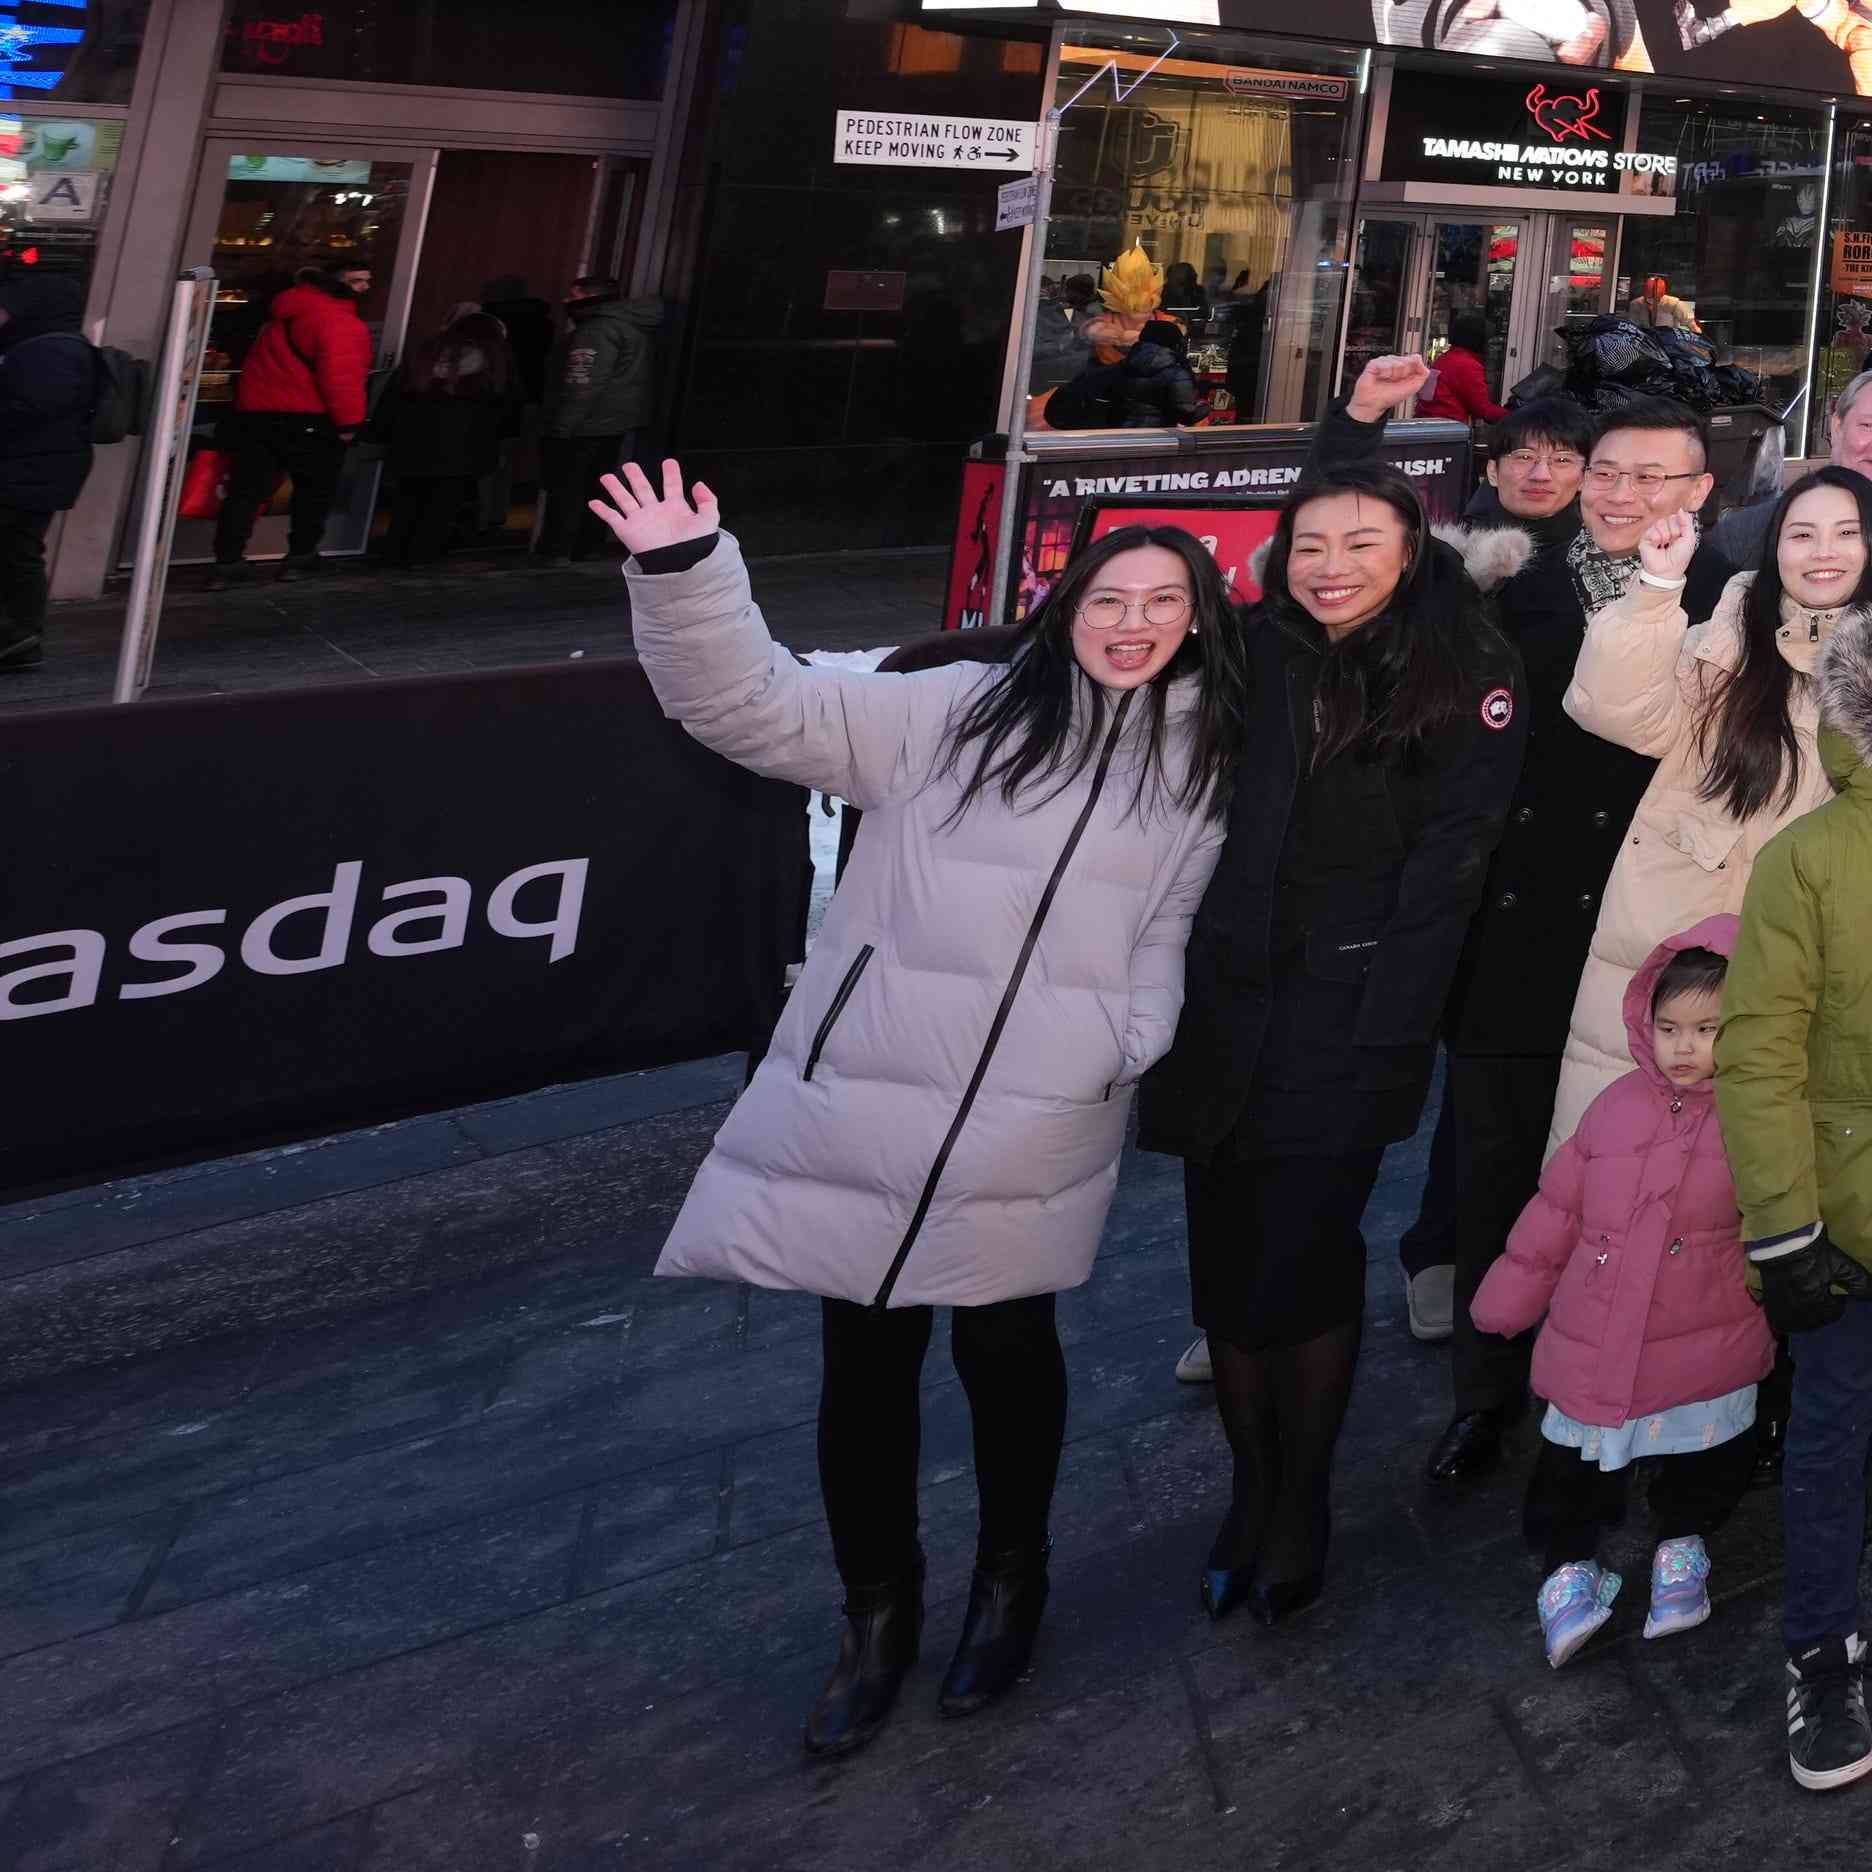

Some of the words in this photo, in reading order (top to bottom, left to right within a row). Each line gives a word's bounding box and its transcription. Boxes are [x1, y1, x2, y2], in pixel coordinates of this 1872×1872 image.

[1232, 77, 1286, 89] BANDAI
[1288, 79, 1340, 95] NAMCO
[846, 118, 940, 139] PEDESTRIAN
[944, 124, 983, 141] FLOW
[986, 126, 1023, 143] ZONE
[844, 140, 882, 156] KEEP
[888, 142, 946, 160] MOVING
[1498, 166, 1544, 182] NEW
[1551, 168, 1607, 186] YORK
[1613, 151, 1678, 176] STORE
[1074, 471, 1210, 496] RIVETING
[1213, 466, 1303, 493] ADREN
[0, 857, 590, 1021] asdaq
